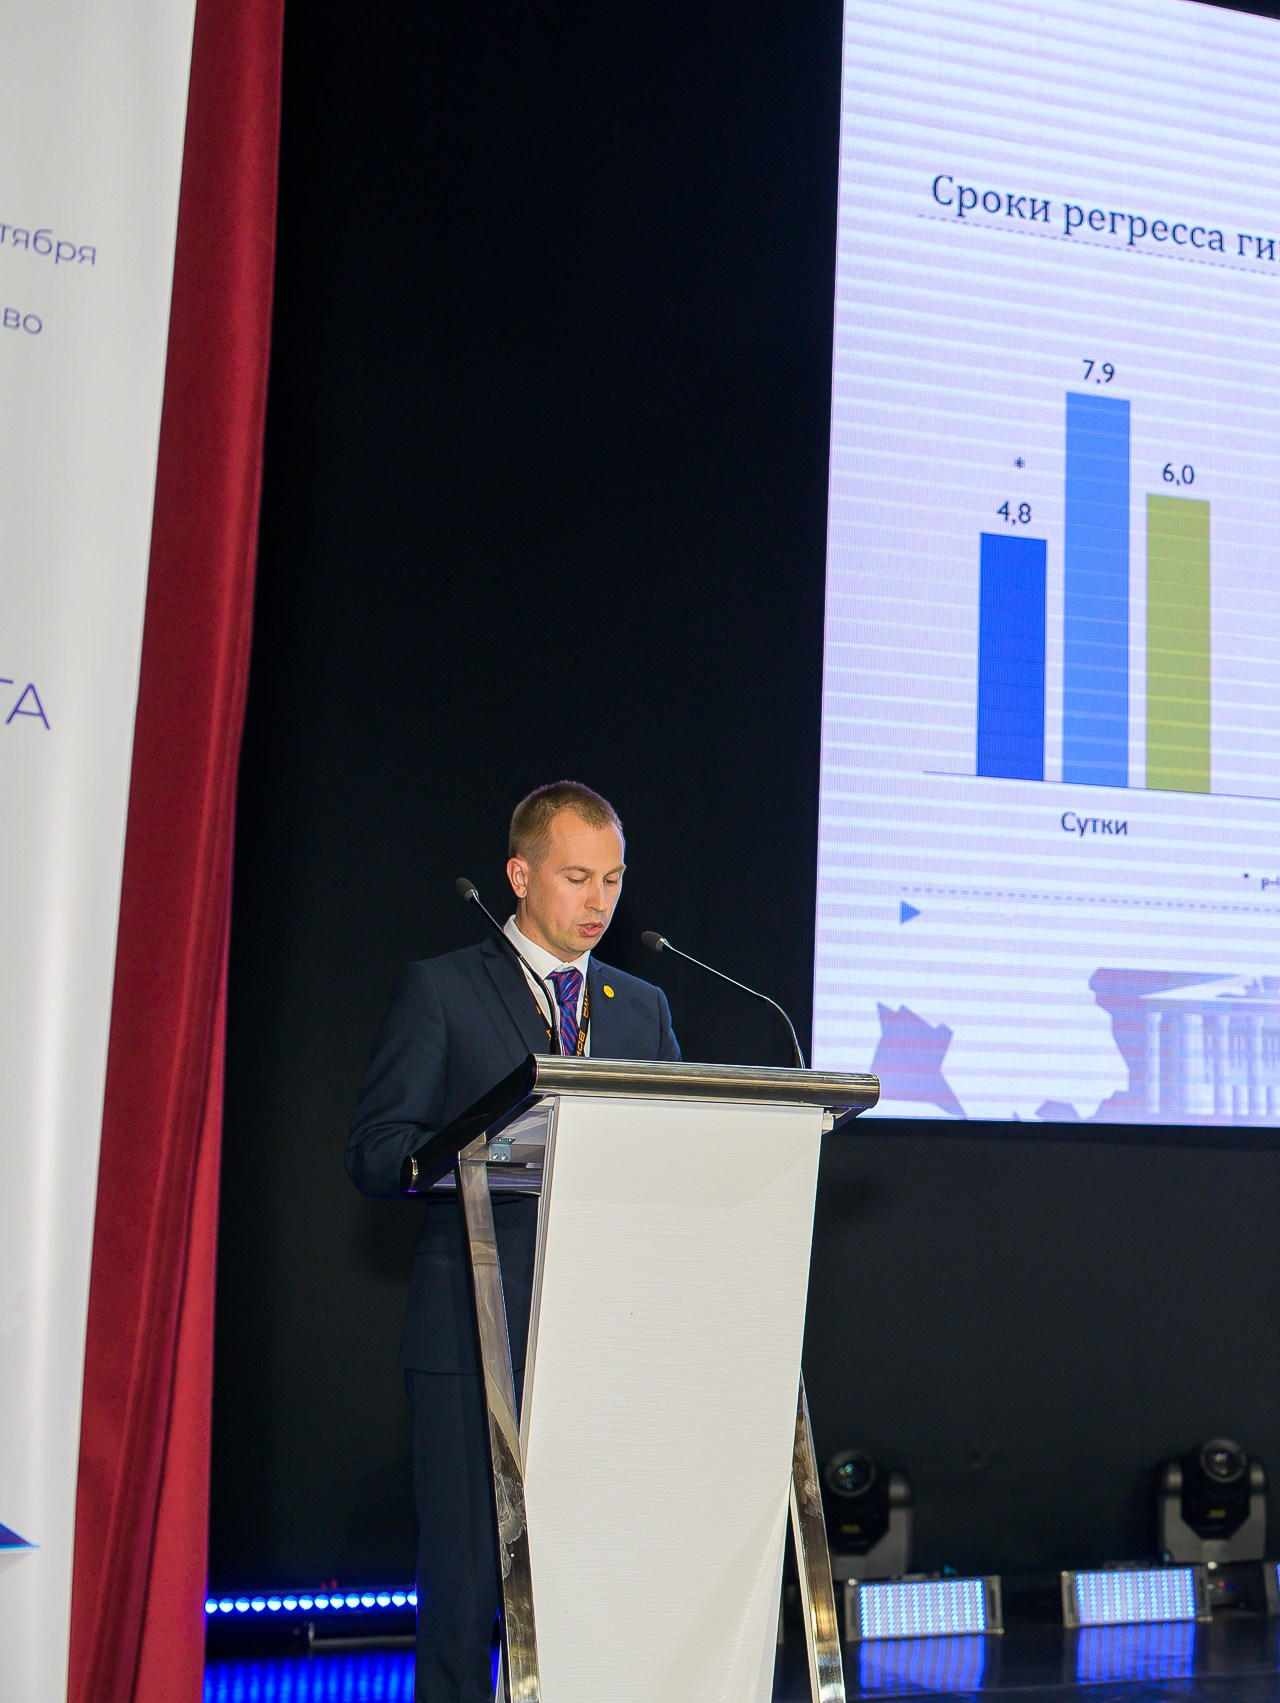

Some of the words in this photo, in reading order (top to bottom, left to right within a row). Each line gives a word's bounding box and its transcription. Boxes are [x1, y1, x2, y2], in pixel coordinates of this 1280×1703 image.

[932, 174, 1051, 224] Сроки
[1063, 203, 1225, 252] регресса
[1082, 359, 1115, 385] 7,9
[1162, 462, 1195, 486] 6,0
[996, 500, 1032, 525] 4,8
[1060, 811, 1129, 837] Сутки
